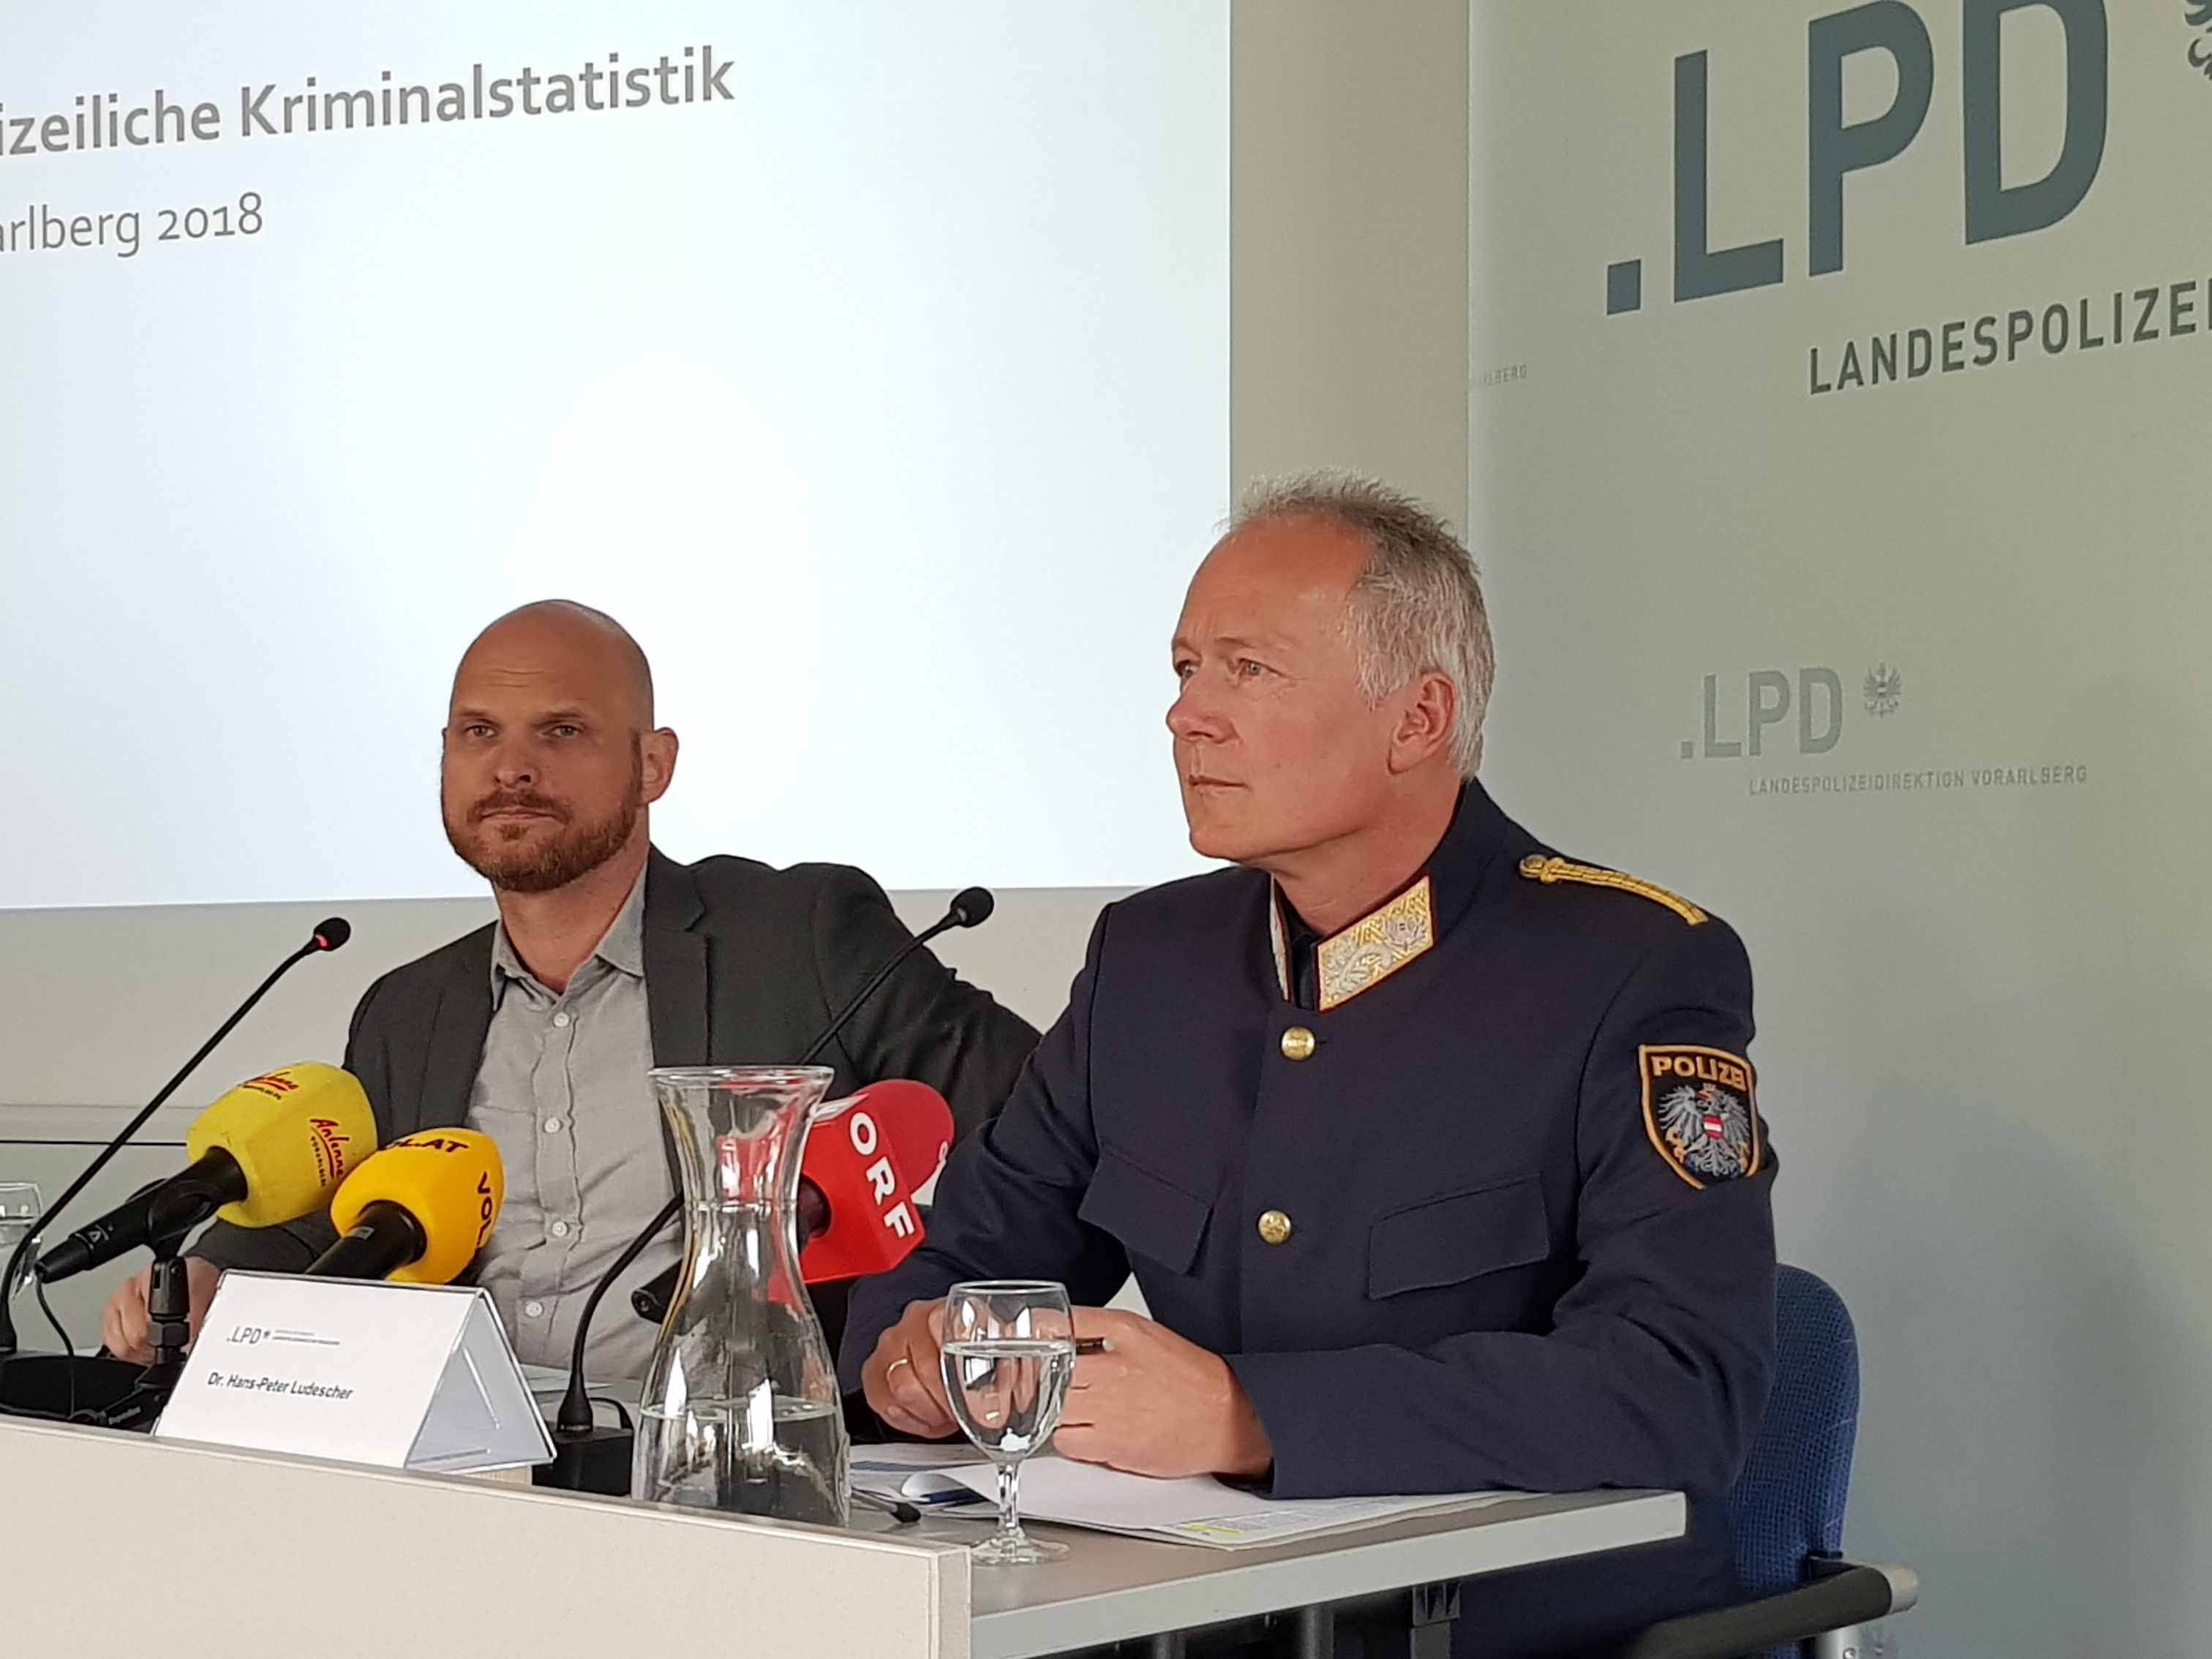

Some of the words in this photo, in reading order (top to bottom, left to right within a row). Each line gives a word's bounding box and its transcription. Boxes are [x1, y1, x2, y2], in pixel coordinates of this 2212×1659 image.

[241, 45, 735, 137] Kriminalstatistik
[0, 203, 140, 258] rlberg
[157, 192, 263, 243] 2018
[1748, 770, 1964, 796] LANDESPOLIZEIDIREKTION
[1971, 765, 2088, 786] VORARLBERG
[309, 1118, 349, 1176] Antenne
[849, 1112, 915, 1238] ORF
[207, 1372, 224, 1386] Dr.
[226, 1374, 290, 1393] Hans-Peter
[290, 1380, 354, 1399] Ludescher
